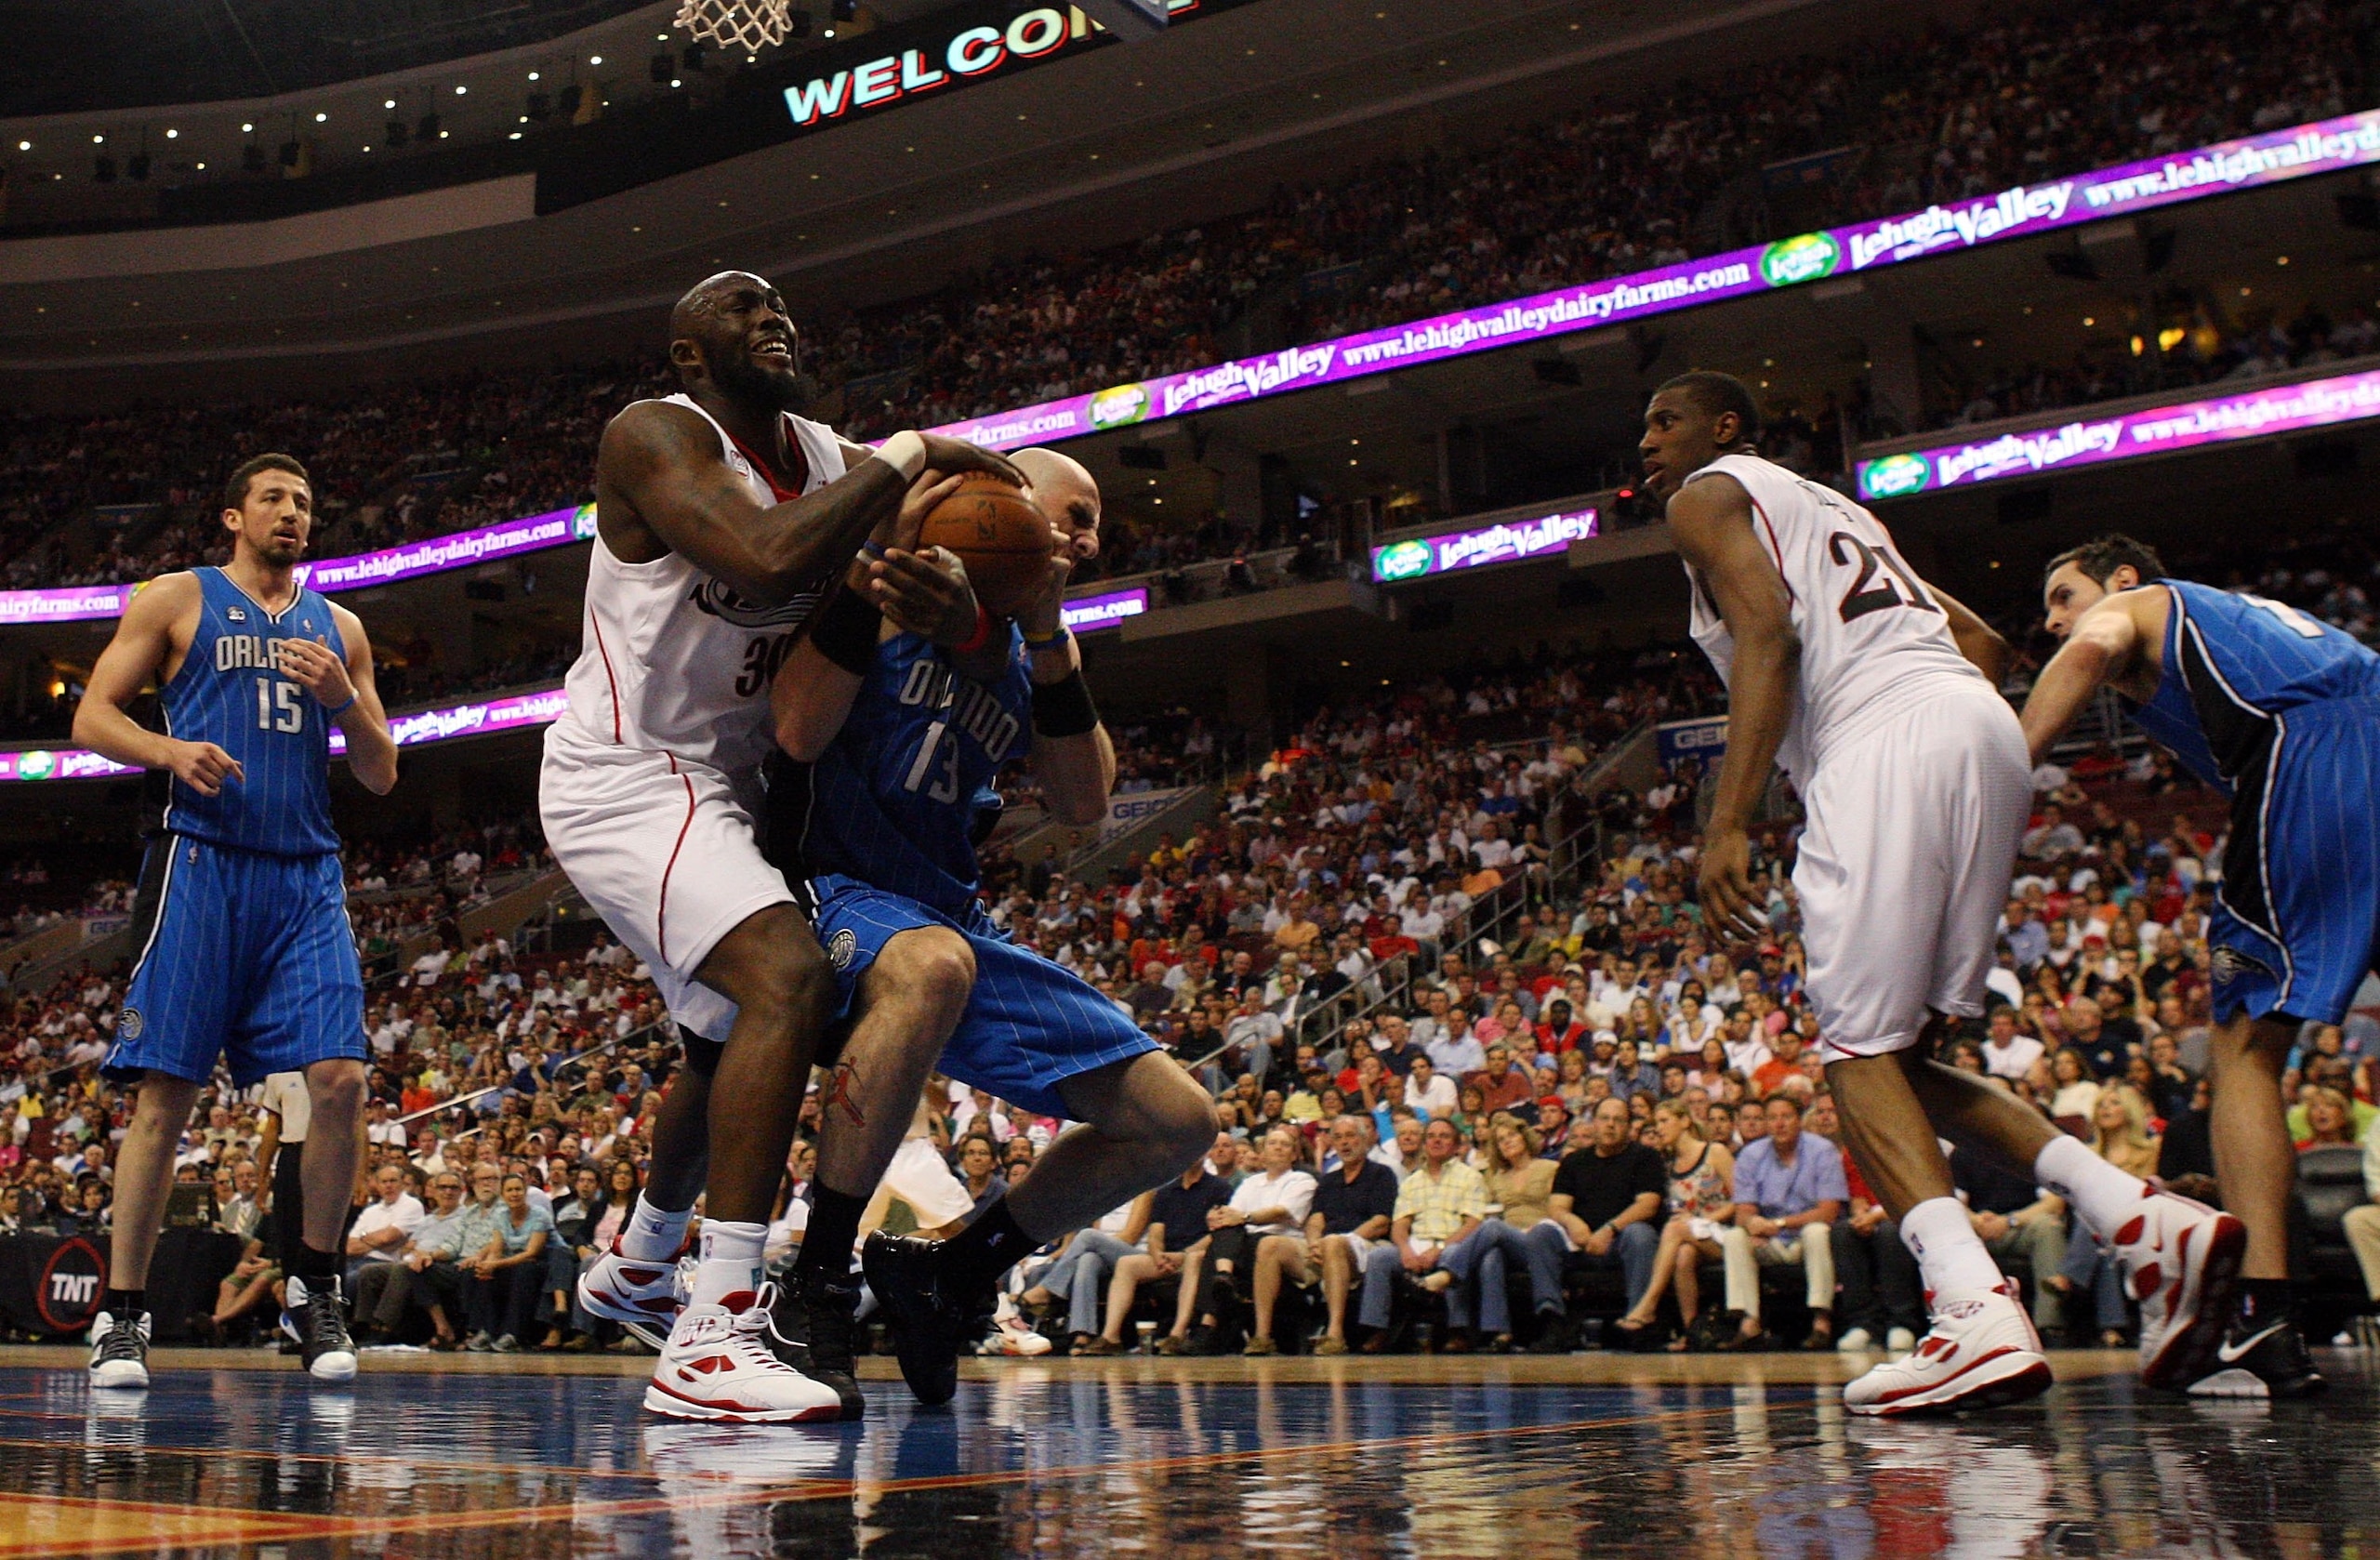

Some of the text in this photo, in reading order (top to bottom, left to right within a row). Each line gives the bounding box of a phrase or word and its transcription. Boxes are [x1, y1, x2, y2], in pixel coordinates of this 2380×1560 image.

[1953, 181, 2073, 245] Valley
[2083, 121, 2380, 207] www.lehighvalleyd
[1342, 261, 1751, 366] www.lehighvalleydairyfarms.com
[1244, 345, 1335, 397] Valley
[961, 411, 1076, 444] farms.com
[2024, 420, 2123, 469] Valley
[316, 520, 566, 585] www.lehighvalleydairyfarms.com
[1512, 514, 1593, 557] Valley
[1829, 531, 1941, 625] 21
[1061, 599, 1144, 626] arms.com
[216, 635, 288, 672] ORLA
[257, 678, 303, 734] 15
[438, 706, 487, 737] Valley
[904, 721, 959, 805] 13
[52, 1273, 99, 1302] TNT
